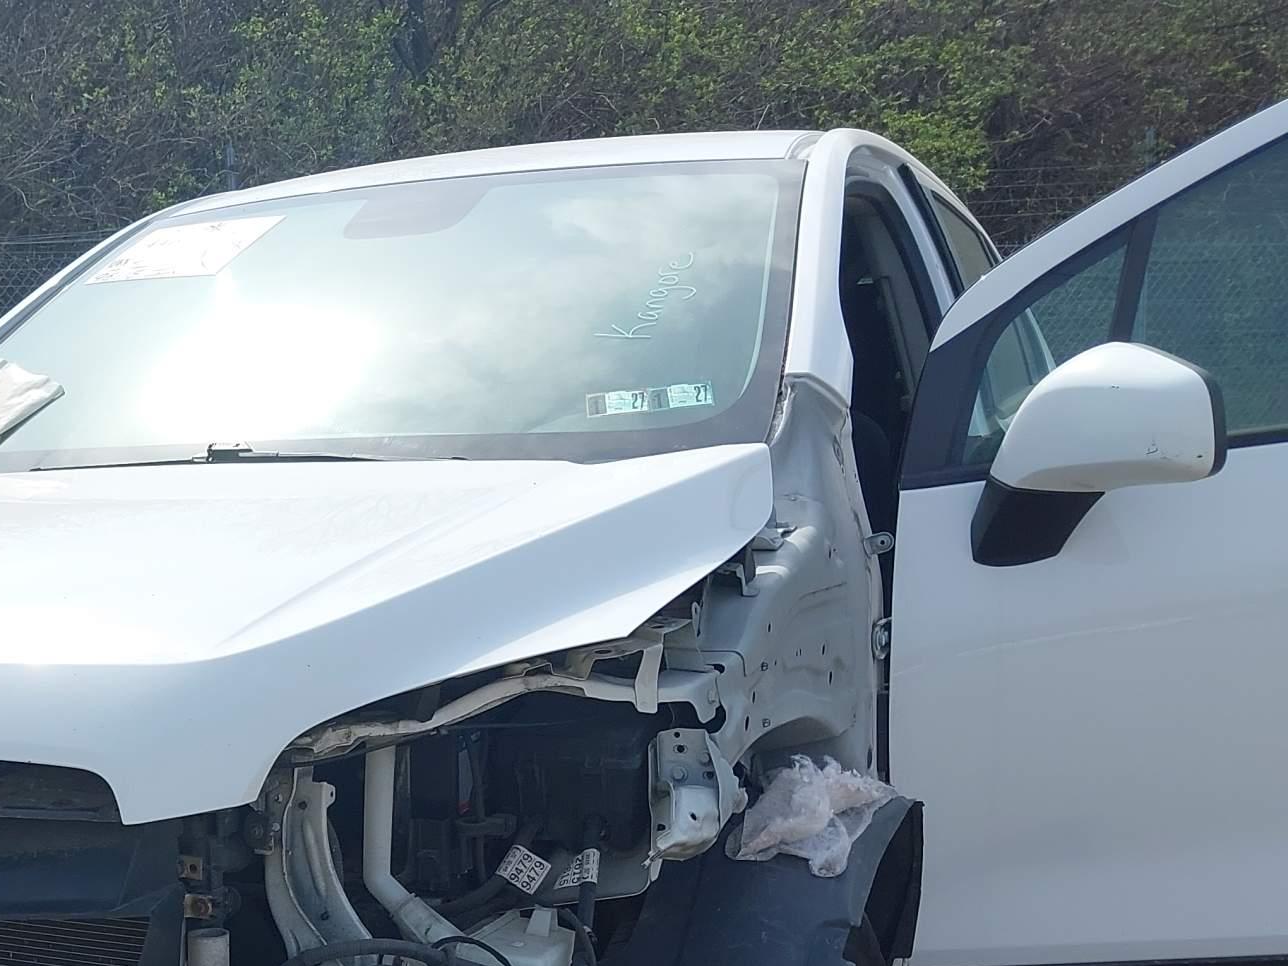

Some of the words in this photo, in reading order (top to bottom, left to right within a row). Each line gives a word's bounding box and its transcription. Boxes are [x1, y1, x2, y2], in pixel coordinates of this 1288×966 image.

[631, 391, 645, 410] 27
[693, 385, 708, 403] 27
[509, 852, 533, 883] 9479
[521, 860, 545, 891] 9479
